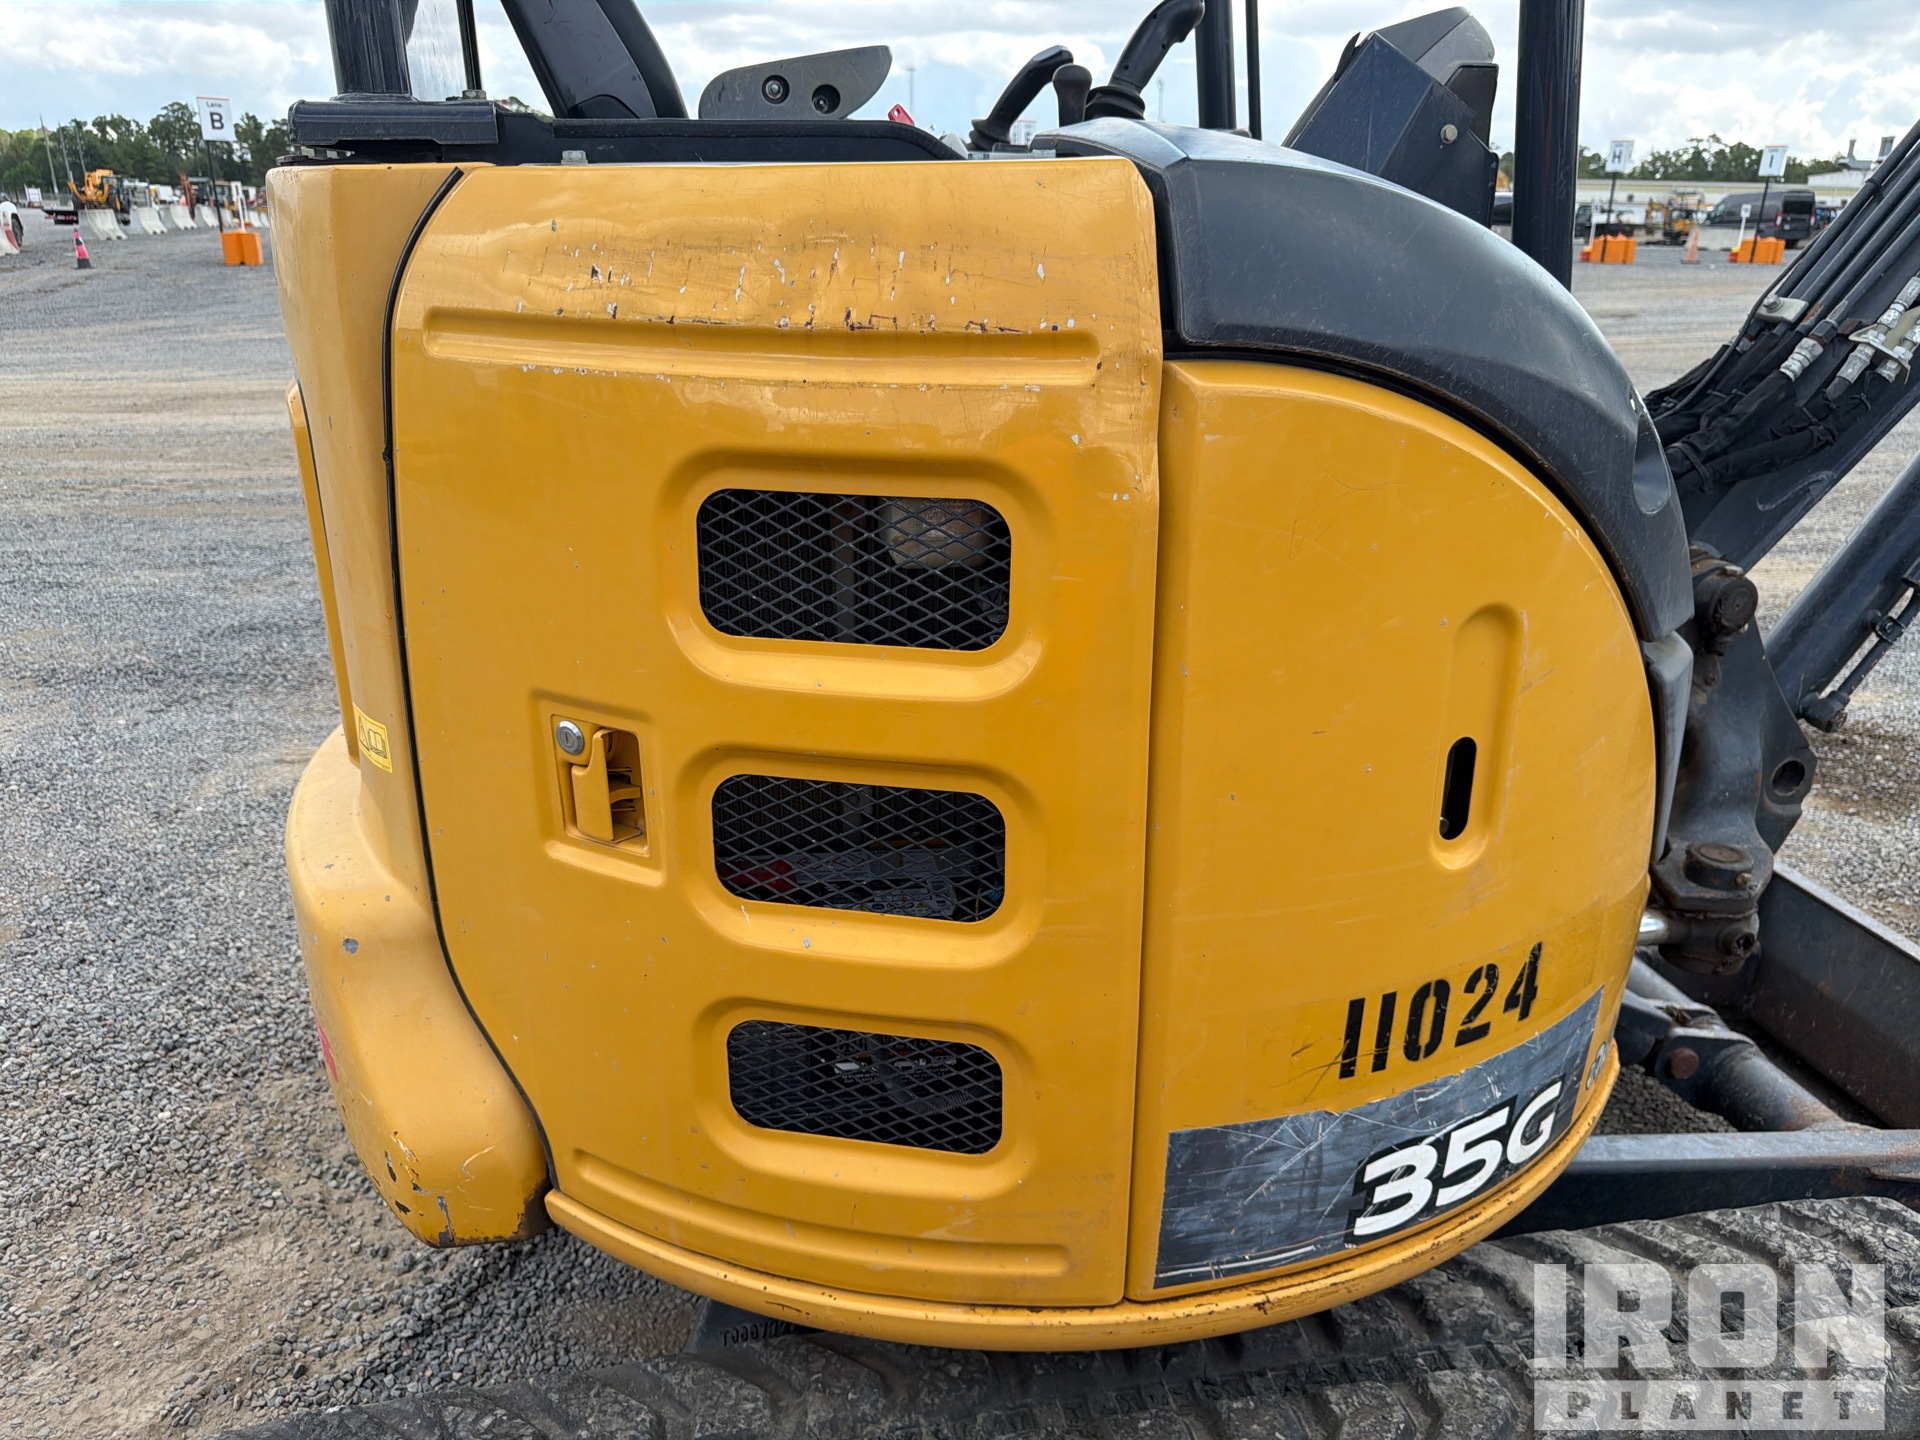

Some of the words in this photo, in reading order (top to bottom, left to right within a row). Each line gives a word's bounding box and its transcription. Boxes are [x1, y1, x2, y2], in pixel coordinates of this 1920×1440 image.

[210, 112, 225, 130] B
[1611, 149, 1623, 164] H
[1338, 941, 1542, 1080] 11024
[1352, 1079, 1565, 1237] 35G
